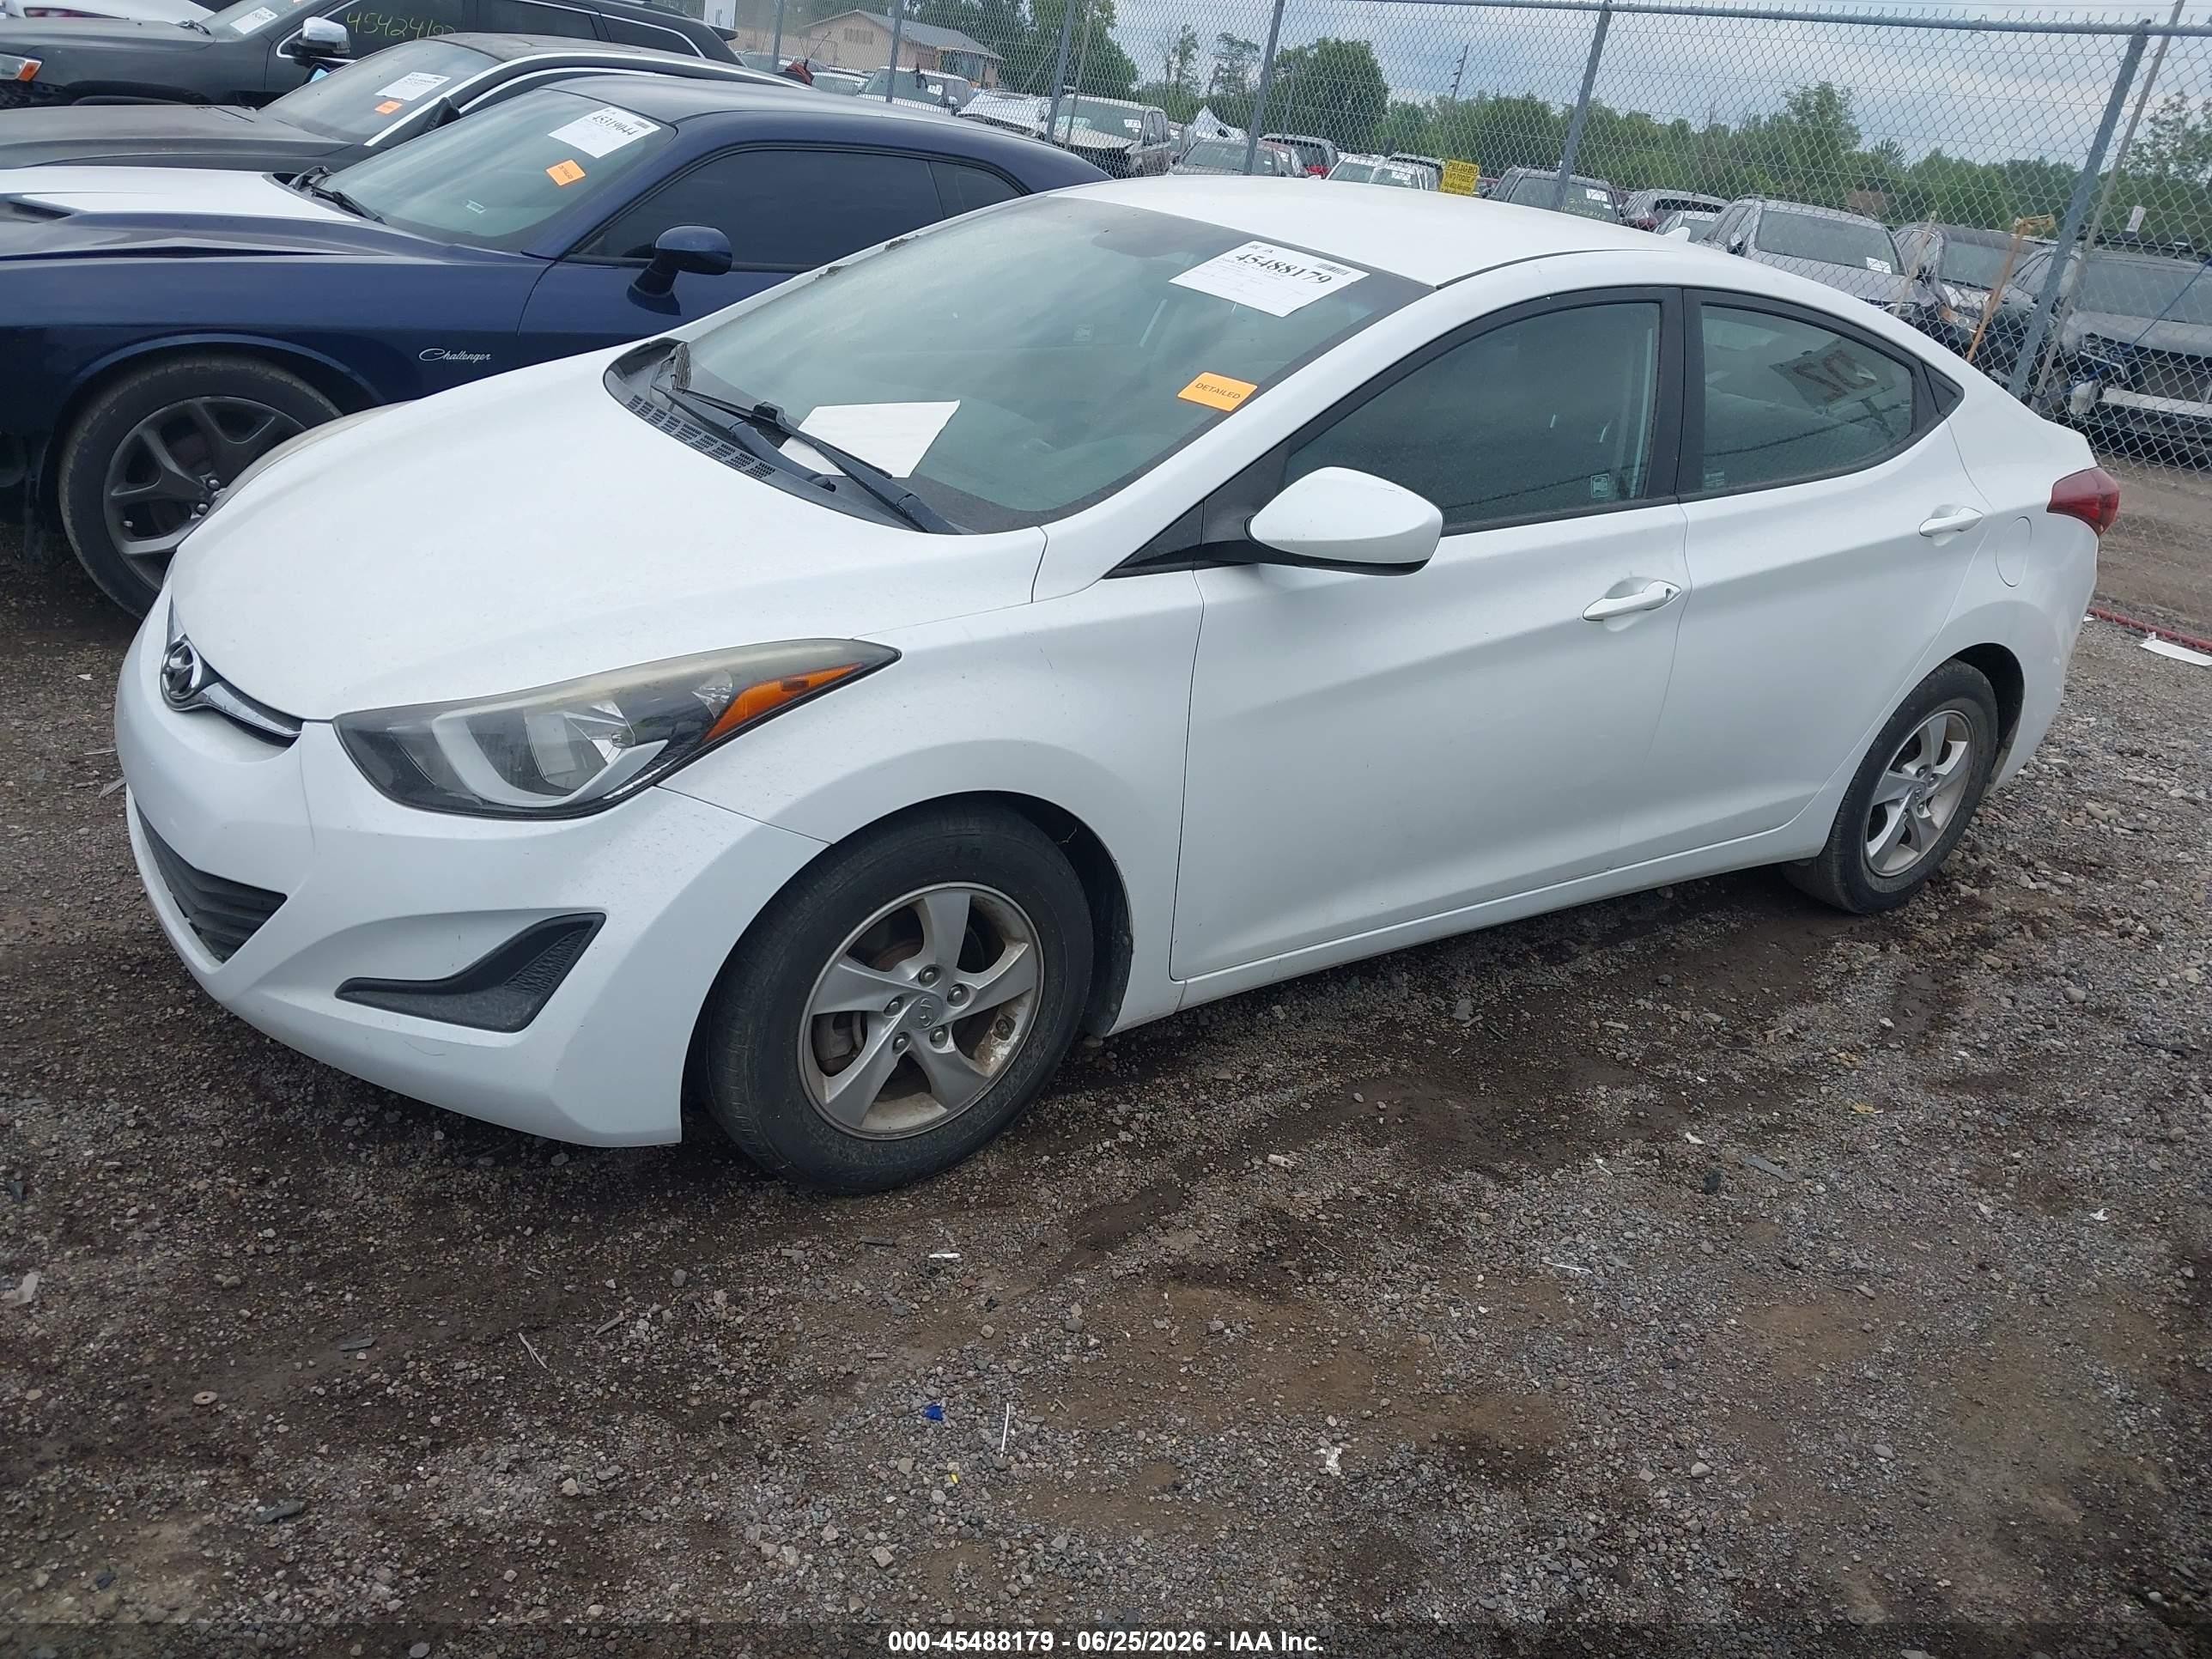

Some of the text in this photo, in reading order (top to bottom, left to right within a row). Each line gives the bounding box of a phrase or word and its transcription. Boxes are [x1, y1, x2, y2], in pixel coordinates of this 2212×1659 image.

[1235, 252, 1333, 284] 45488179
[419, 348, 492, 364] Challenger
[1194, 382, 1241, 399] DETAILED
